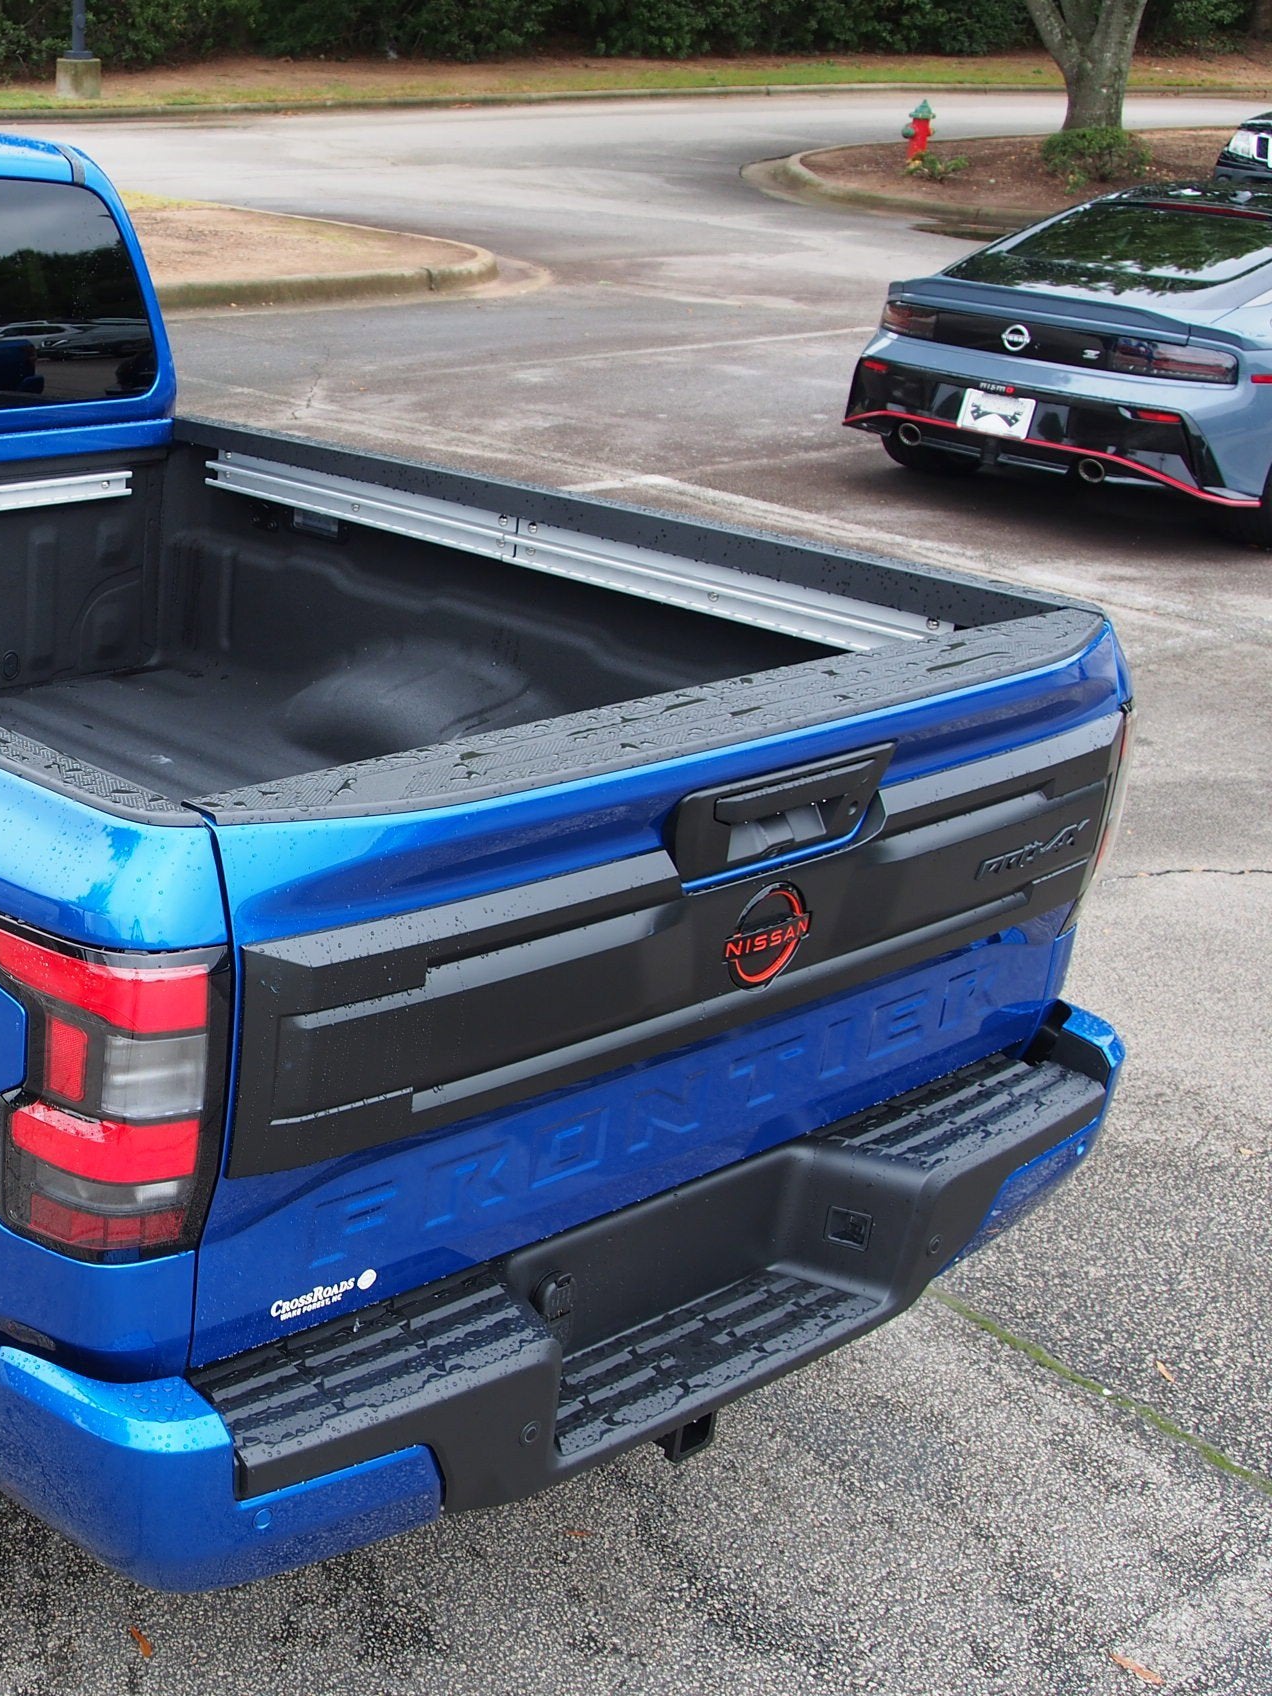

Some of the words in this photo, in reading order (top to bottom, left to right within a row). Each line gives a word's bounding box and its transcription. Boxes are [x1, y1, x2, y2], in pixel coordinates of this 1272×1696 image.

[725, 919, 810, 958] NISSAN
[308, 962, 1002, 1270] FRONTIER
[280, 1308, 301, 1321] WAKE
